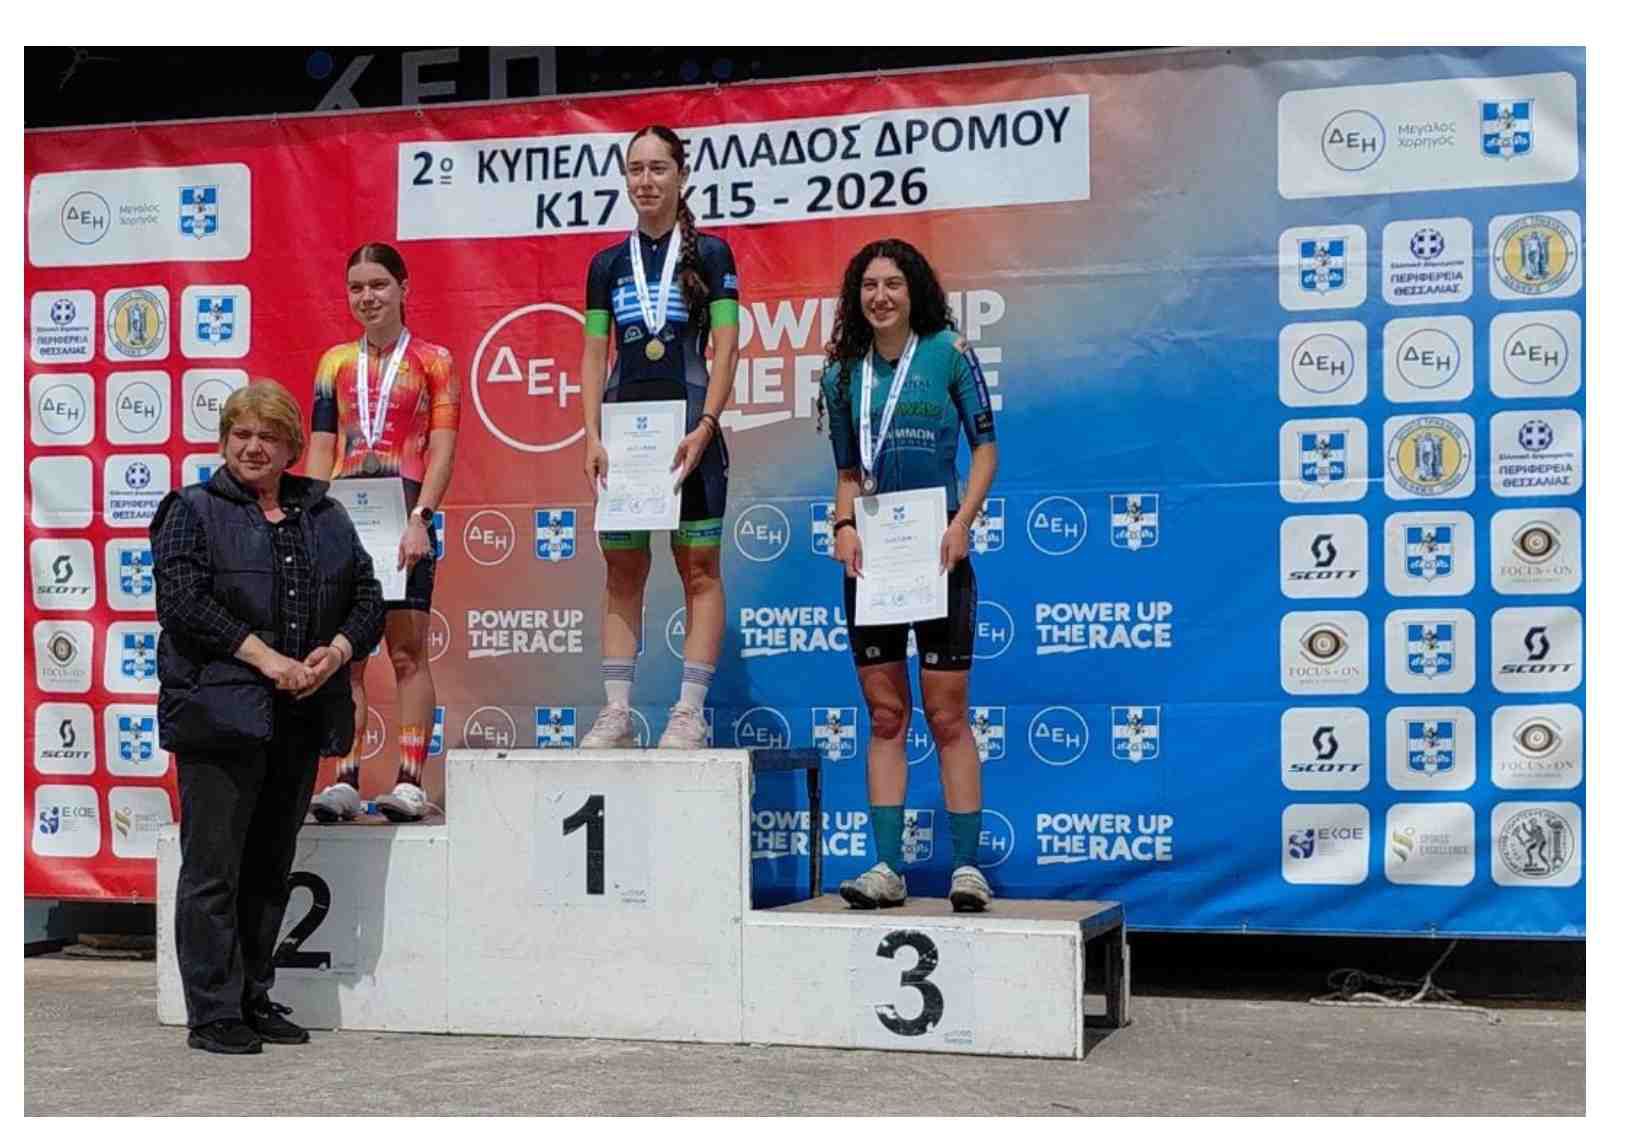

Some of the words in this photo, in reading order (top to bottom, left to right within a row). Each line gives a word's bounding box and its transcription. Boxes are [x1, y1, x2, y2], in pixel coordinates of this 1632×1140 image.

[478, 144, 626, 184] ΚΥΠΕΛΛ
[875, 106, 1070, 156] ΔΡΟΜΟΥ
[536, 190, 620, 229] Κ17
[807, 167, 928, 213] 2026
[1289, 570, 1360, 581] SCOTT
[38, 586, 90, 595] SCOTT
[468, 611, 547, 630] POWER
[552, 610, 583, 629] UP
[740, 606, 825, 626] POWER
[834, 606, 847, 625] U
[1036, 602, 1130, 623] POWER
[1137, 601, 1173, 621] UP
[469, 631, 510, 650] THE
[513, 630, 583, 654] RACE
[741, 628, 786, 646] THE
[790, 627, 848, 651] RAC
[978, 622, 1005, 643] ΕΗ
[1037, 625, 1085, 643] THE
[1089, 623, 1172, 649] RACE
[1500, 664, 1573, 674] SCOTT
[41, 750, 90, 759] SCOTT
[1289, 763, 1362, 773] SCOTT
[836, 811, 868, 830] UP
[1036, 814, 1133, 834] POWER
[1140, 814, 1173, 834] UP
[562, 795, 605, 894] 1
[1037, 837, 1087, 855] THE
[1089, 836, 1172, 861] RACE
[274, 871, 332, 968] 2
[874, 929, 944, 1037] 3
